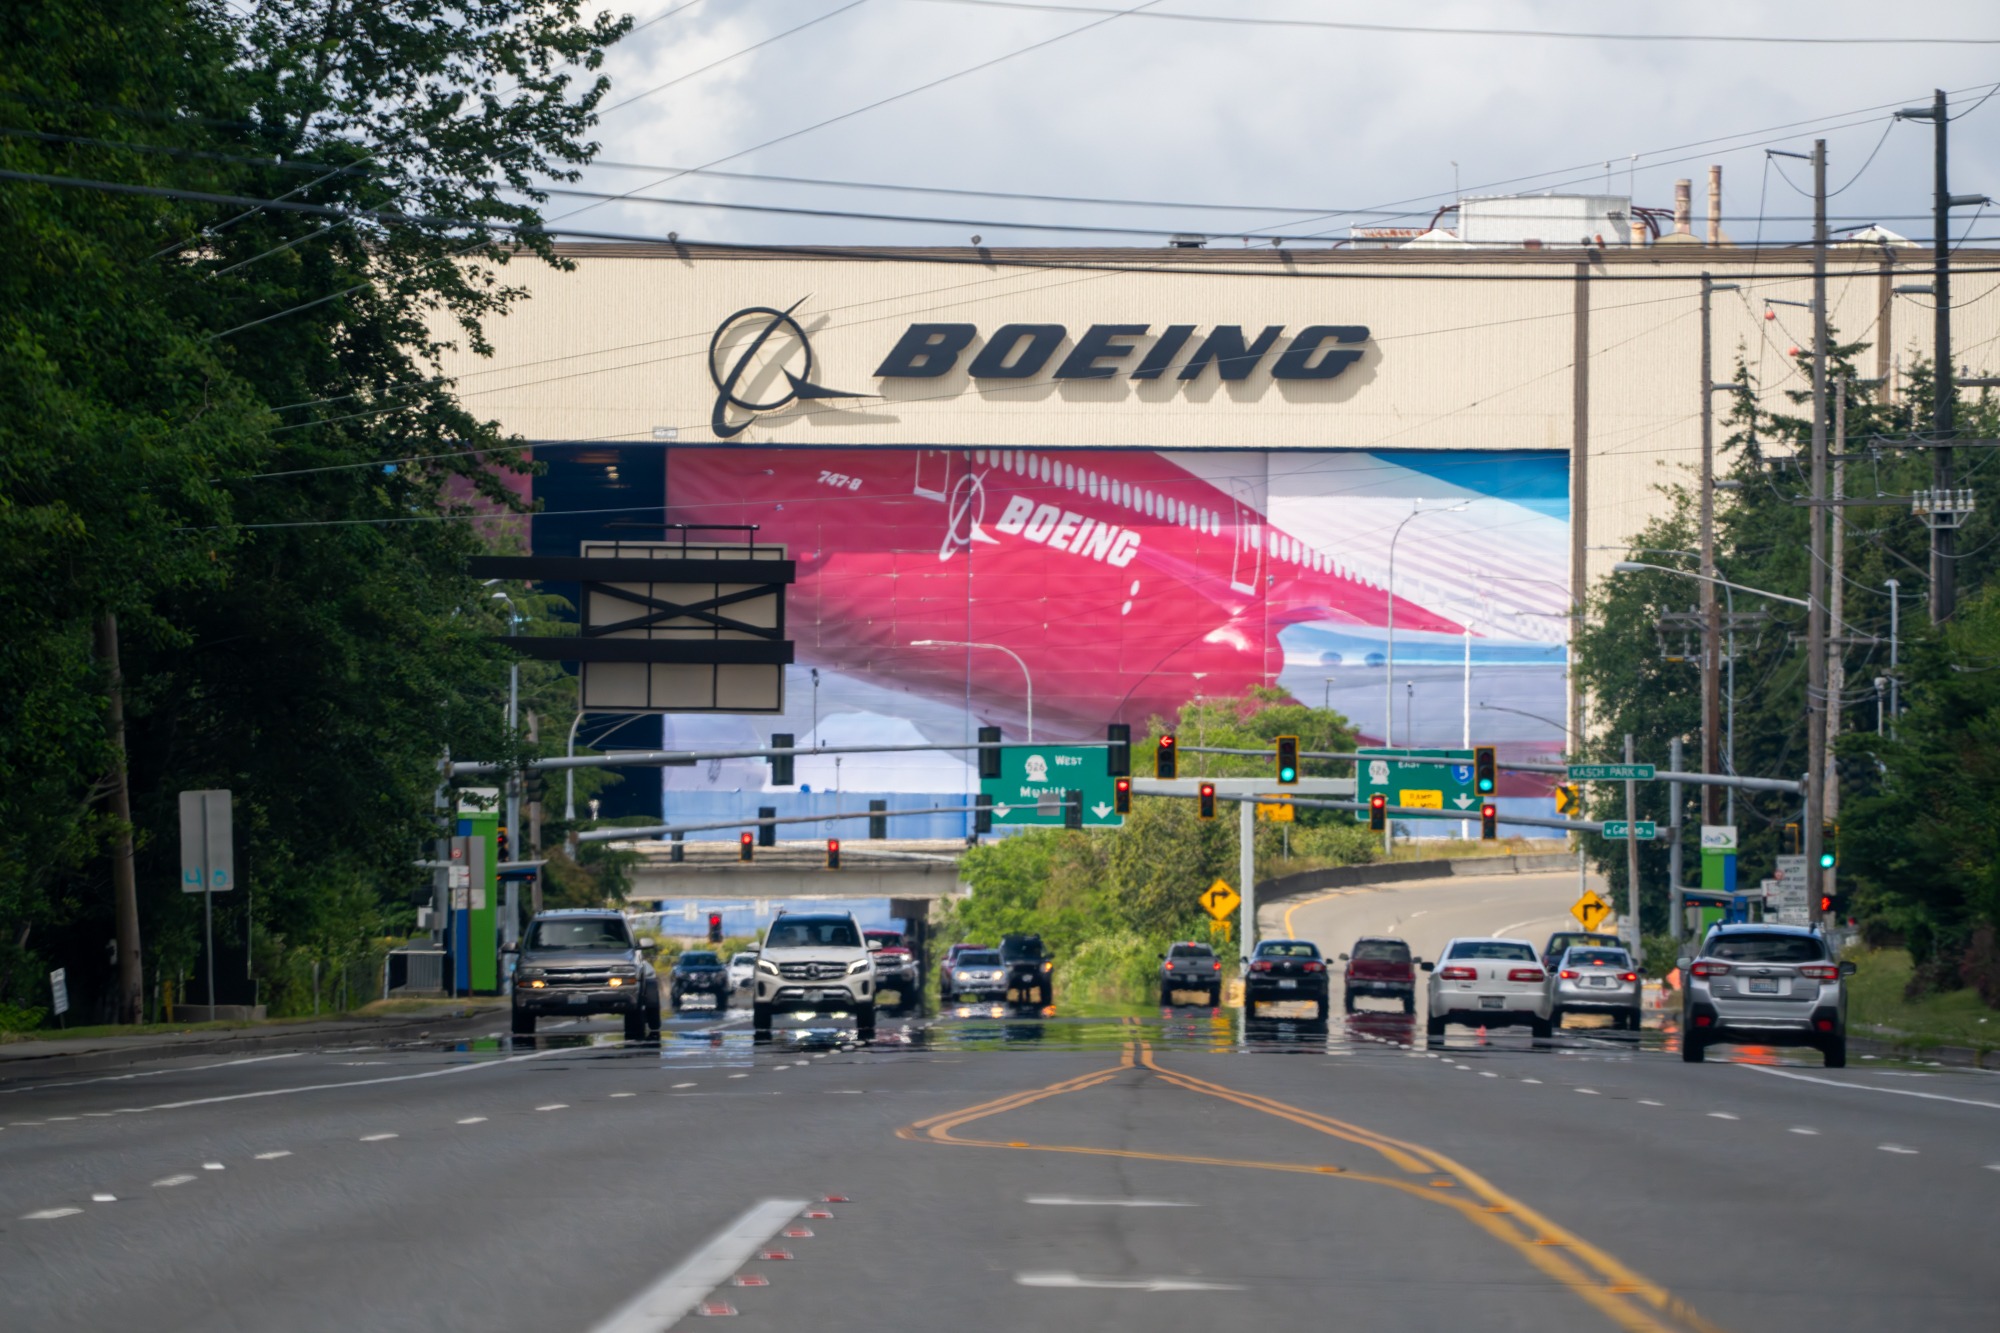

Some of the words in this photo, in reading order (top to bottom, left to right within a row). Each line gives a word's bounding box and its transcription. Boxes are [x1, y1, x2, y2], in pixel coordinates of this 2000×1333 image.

[873, 323, 1370, 380] BOEING
[817, 469, 863, 491] 747-8
[995, 495, 1141, 568] BOEING
[1459, 765, 1469, 780] 5
[1572, 767, 1605, 777] KASCH
[1609, 767, 1635, 777] PARK
